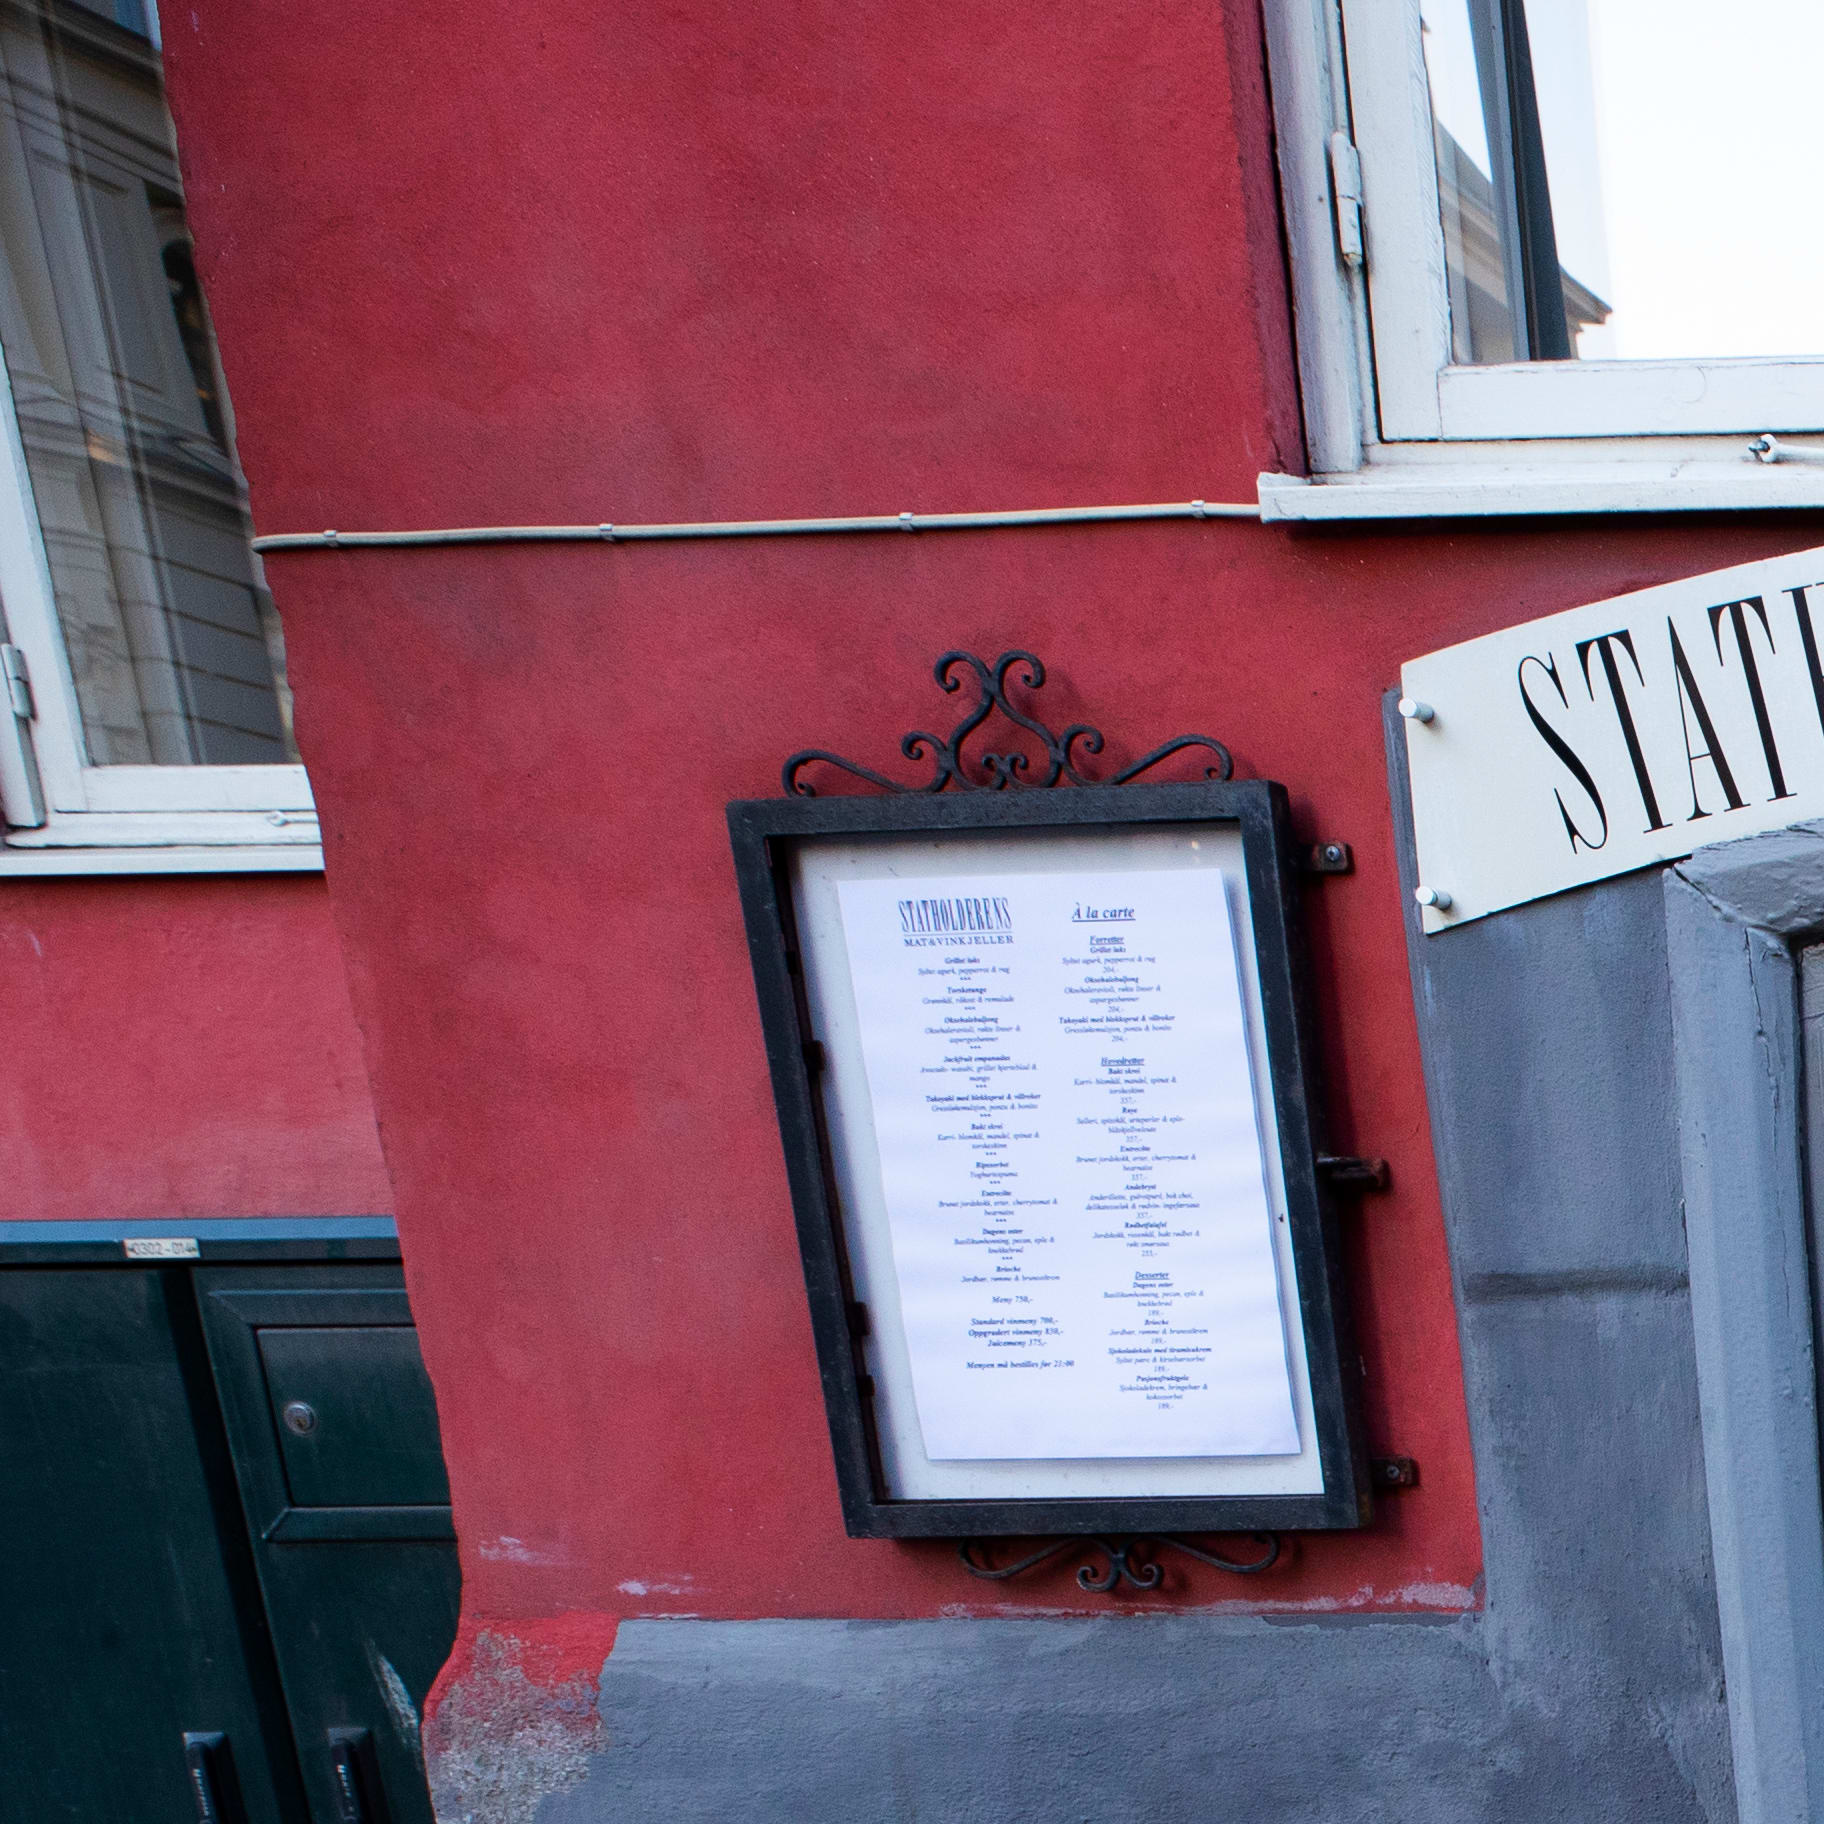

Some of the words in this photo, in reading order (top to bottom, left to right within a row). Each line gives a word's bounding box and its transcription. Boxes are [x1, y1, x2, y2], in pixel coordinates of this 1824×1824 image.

[898, 897, 1012, 932] STATHOLDERENS
[1086, 906, 1098, 919] la
[1102, 907, 1135, 919] carte
[904, 935, 1015, 947] MAT&VINKJELLER
